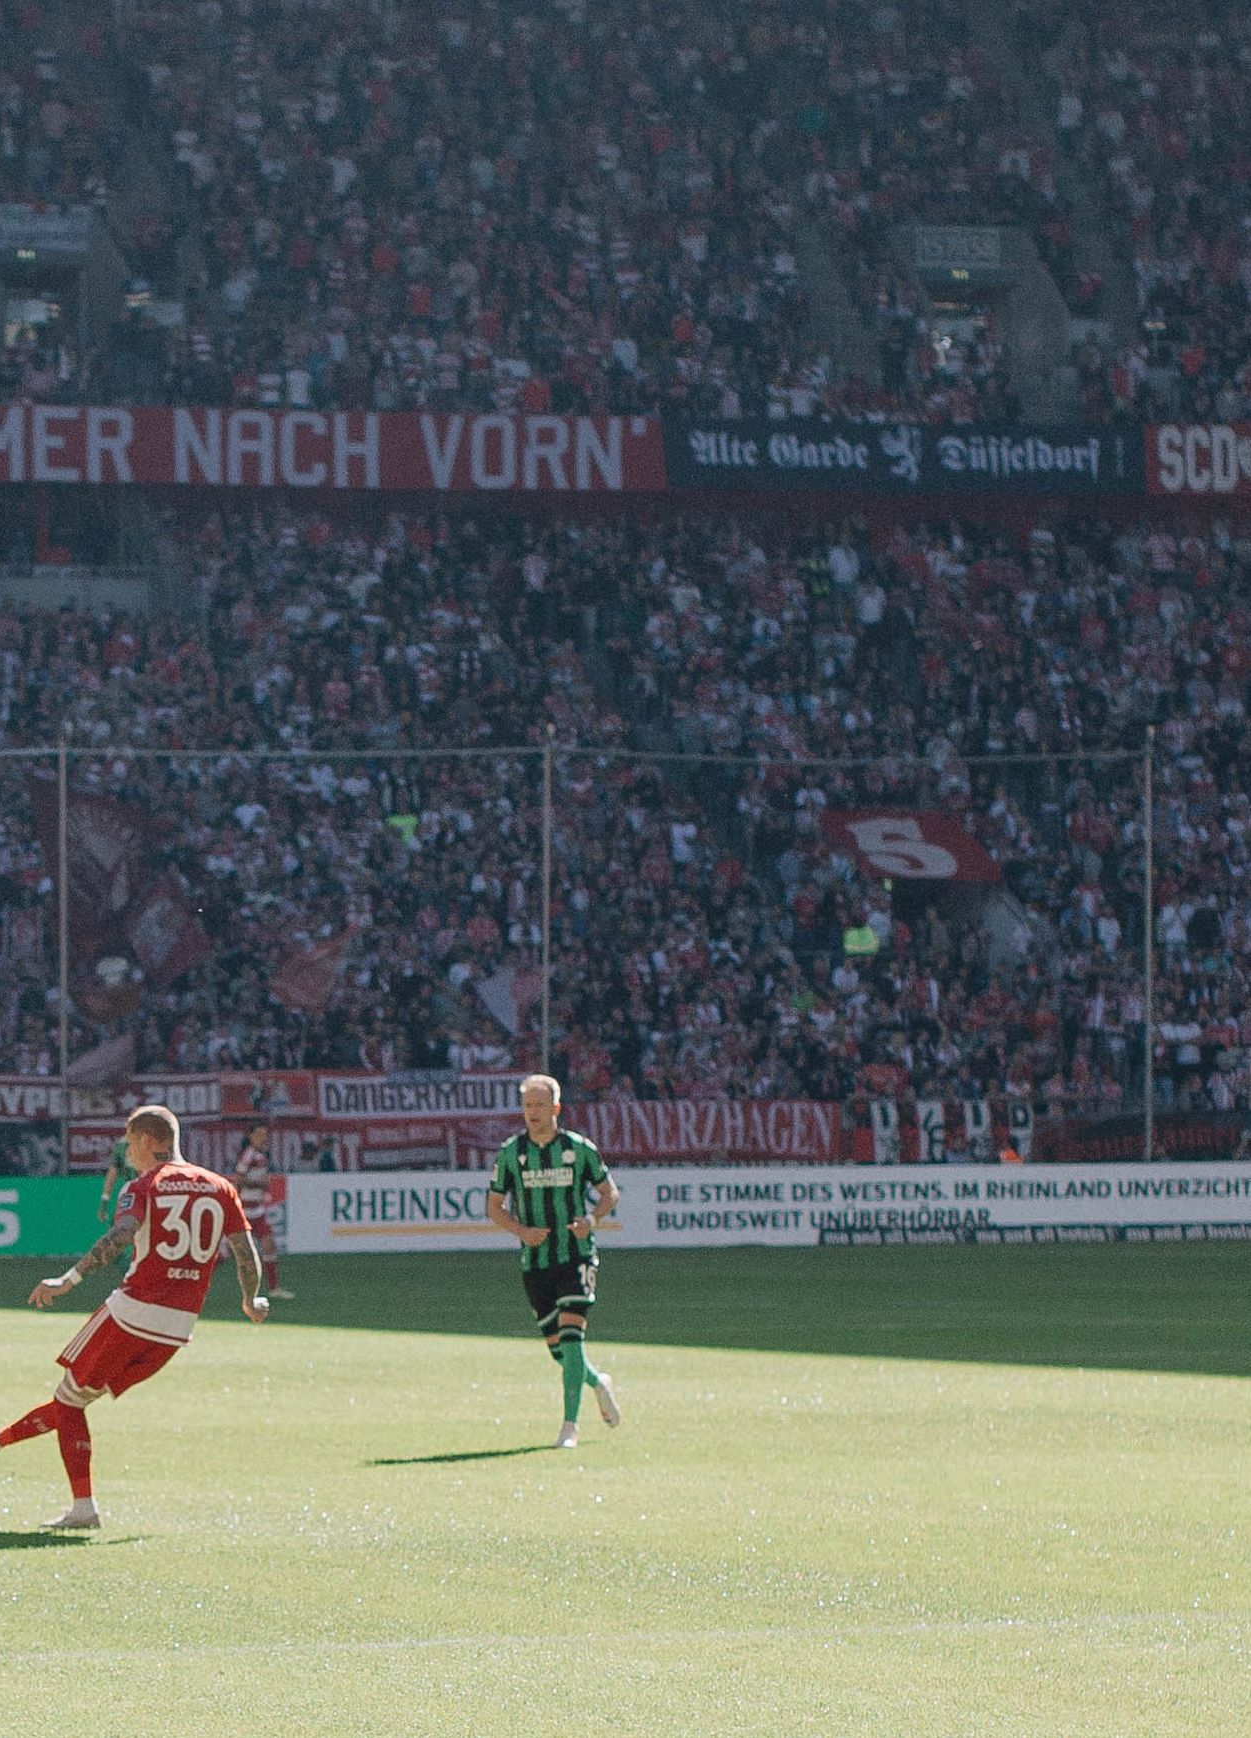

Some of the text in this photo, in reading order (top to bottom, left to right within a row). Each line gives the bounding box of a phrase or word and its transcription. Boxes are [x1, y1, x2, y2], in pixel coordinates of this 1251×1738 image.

[174, 406, 381, 489] NACH
[689, 429, 757, 467] Alte
[767, 431, 869, 468] Garde
[332, 1188, 491, 1222] RHEINISC
[655, 1183, 693, 1202] DIE
[699, 1183, 785, 1202] STIMME
[791, 1183, 833, 1201] DES
[954, 1180, 979, 1199] IM
[987, 1179, 1111, 1199] RHEINLAND
[155, 1195, 225, 1264] 30
[657, 1210, 802, 1230] BUNDESWEIT
